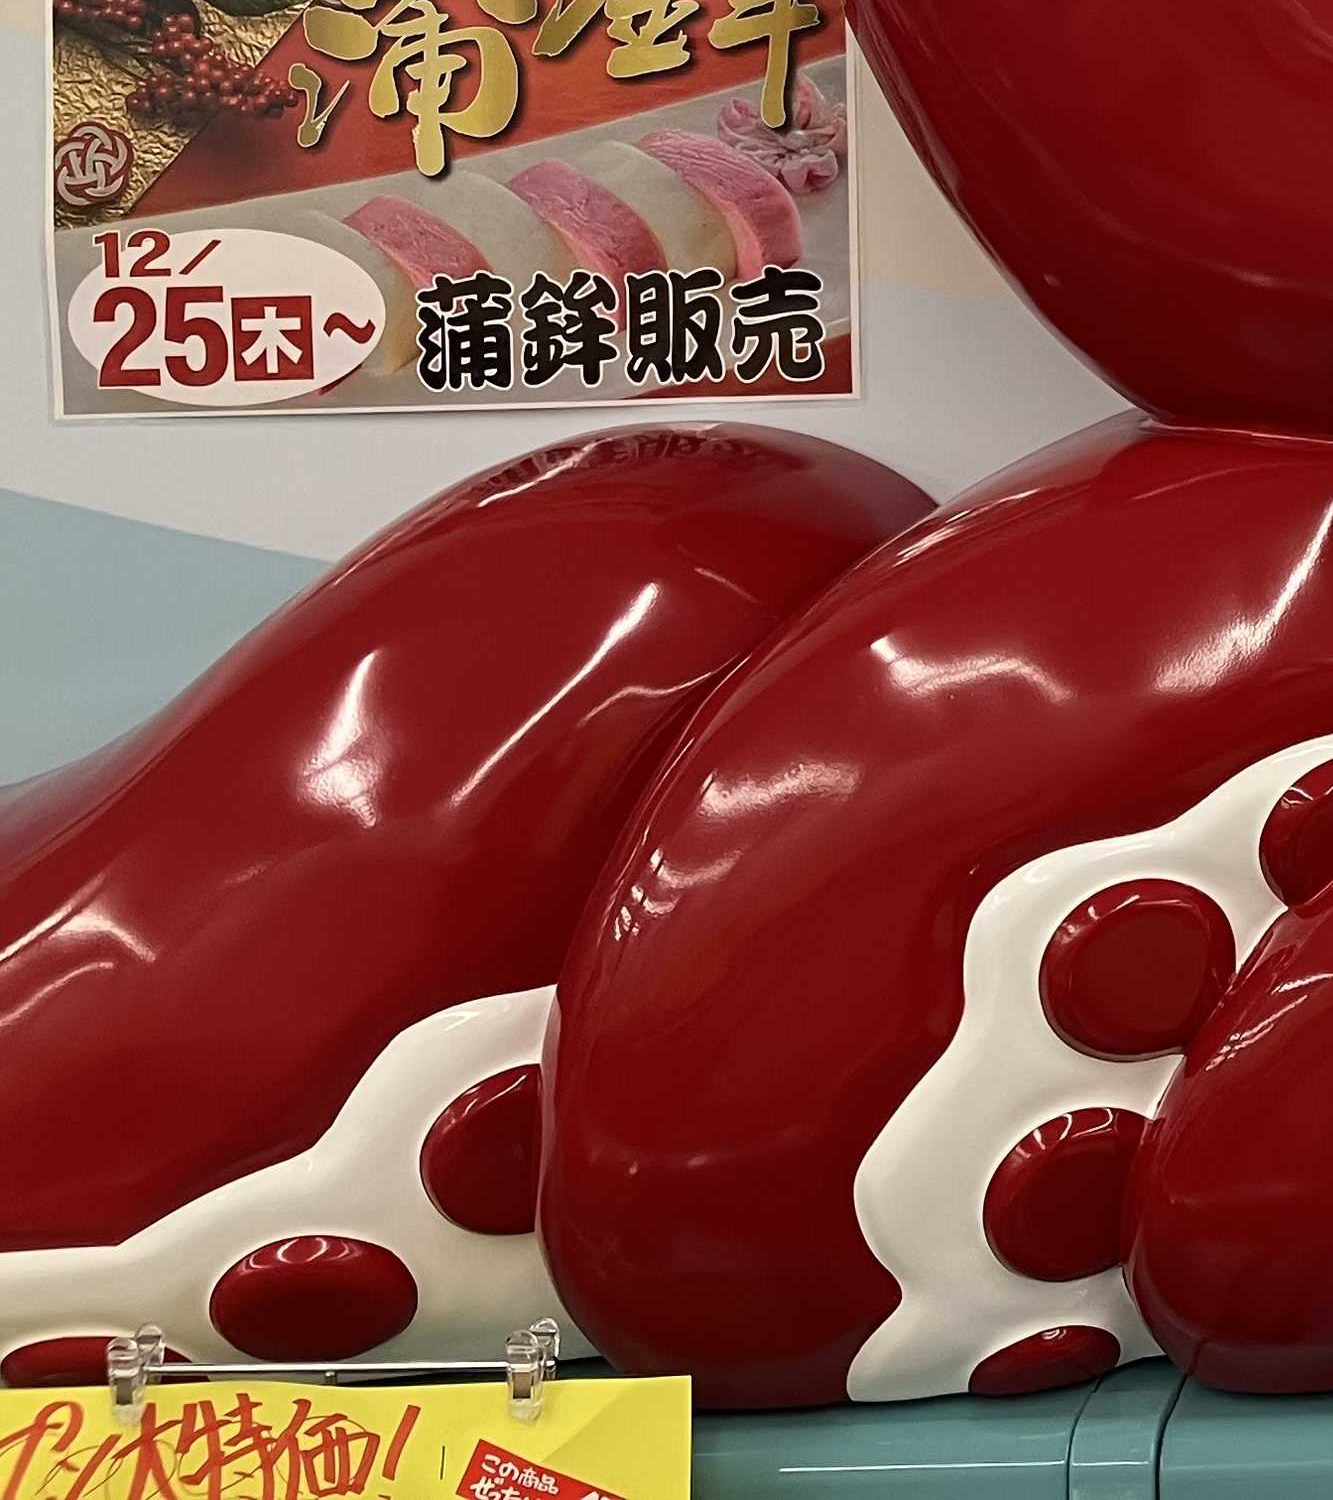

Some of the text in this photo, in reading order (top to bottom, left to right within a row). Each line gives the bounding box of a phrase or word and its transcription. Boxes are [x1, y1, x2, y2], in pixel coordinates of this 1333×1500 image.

[415, 265, 825, 391] 蒲鉾販売
[481, 1453, 560, 1495] この商品
